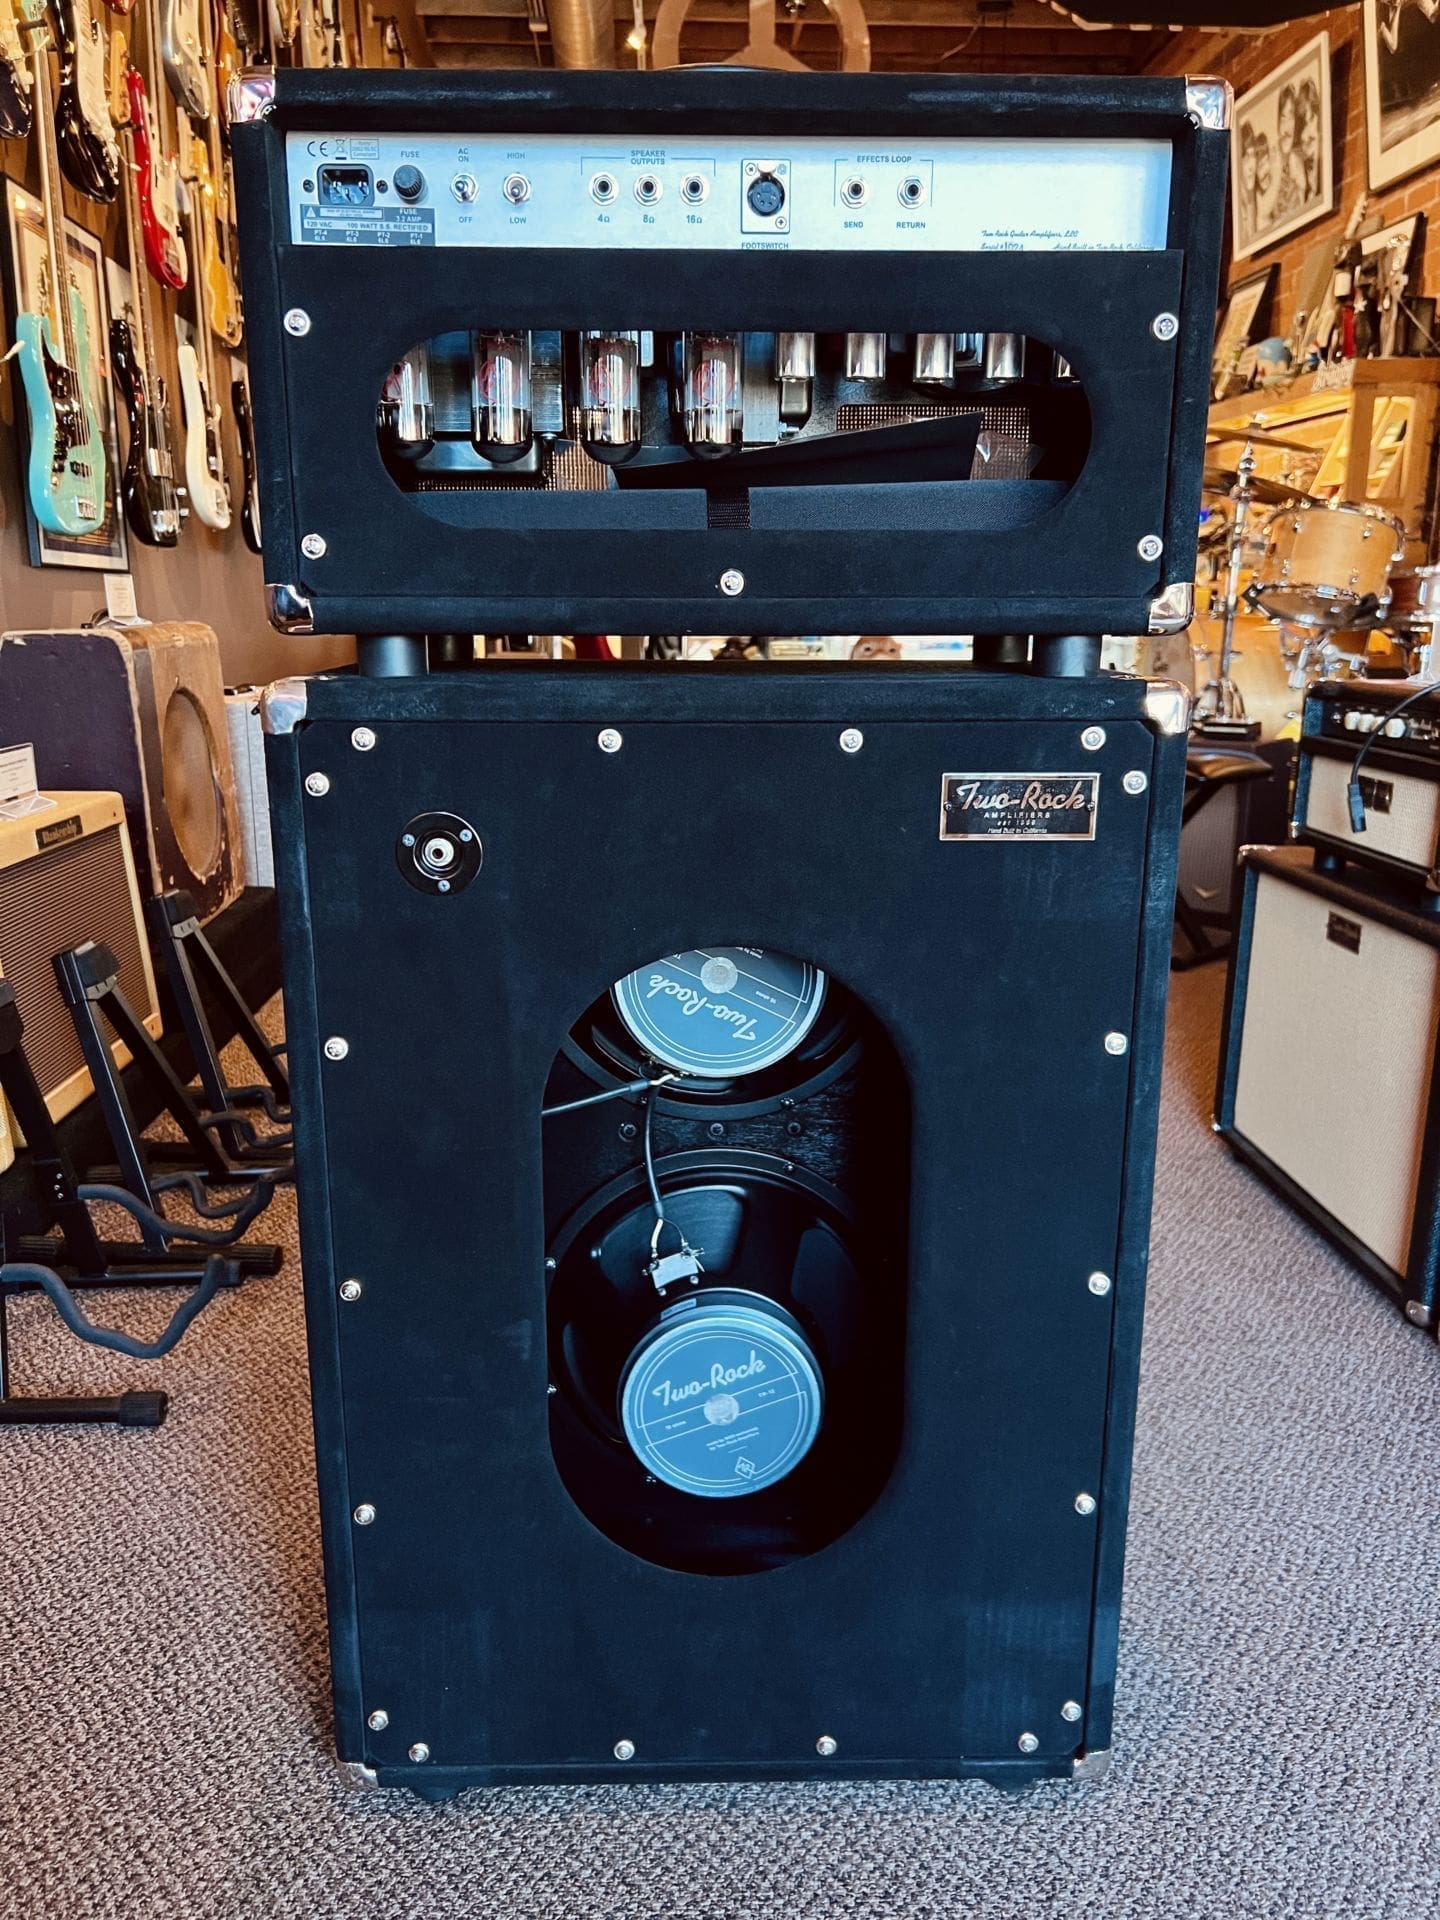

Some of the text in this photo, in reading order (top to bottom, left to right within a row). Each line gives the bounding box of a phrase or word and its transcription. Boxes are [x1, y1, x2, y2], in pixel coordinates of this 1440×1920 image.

[458, 155, 469, 163] ON
[458, 216, 473, 224] OFF
[393, 223, 429, 231] RECTIFIED
[956, 781, 1086, 811] Two-Rock
[983, 811, 1051, 819] AMPLIFIERS
[645, 974, 759, 1042] Two-Rock
[652, 1350, 766, 1407] Two-Rock
